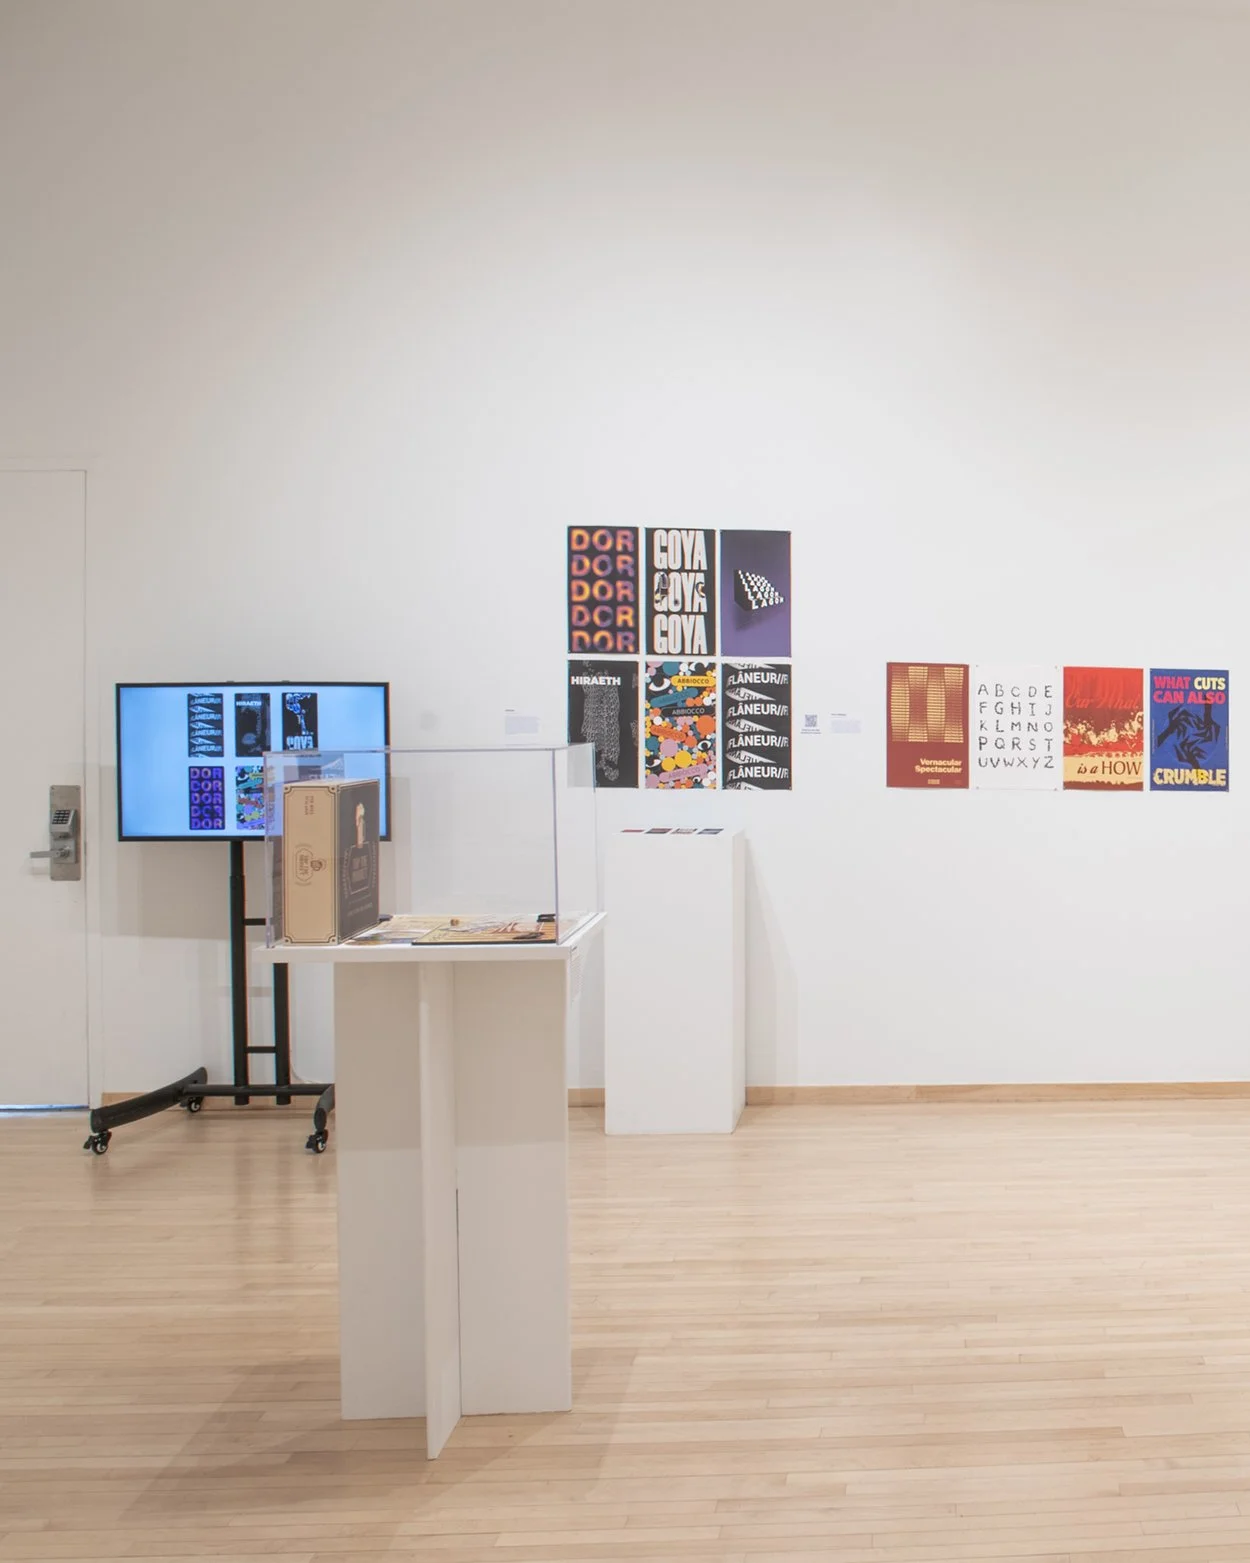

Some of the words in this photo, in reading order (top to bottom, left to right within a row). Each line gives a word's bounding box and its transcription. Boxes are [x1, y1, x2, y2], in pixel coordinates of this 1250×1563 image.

[571, 529, 634, 552] DOR
[653, 529, 708, 570] GOYA
[571, 554, 634, 577] DOR
[571, 580, 634, 602] DOR
[653, 571, 708, 612] GOYA
[571, 630, 634, 652] DOR
[653, 614, 708, 655] GOYA
[570, 676, 621, 686] HIRAETH
[1153, 676, 1190, 689] WHAT
[1194, 677, 1226, 690] CUTS
[1153, 691, 1184, 703] CAN
[1187, 692, 1226, 705] ALSO
[914, 765, 963, 774] Spectacular
[920, 758, 962, 766] Vernacular
[1077, 763, 1088, 775] is
[1090, 765, 1099, 775] a
[1102, 761, 1142, 775] HOW
[1153, 767, 1227, 787] CRUMBLE
